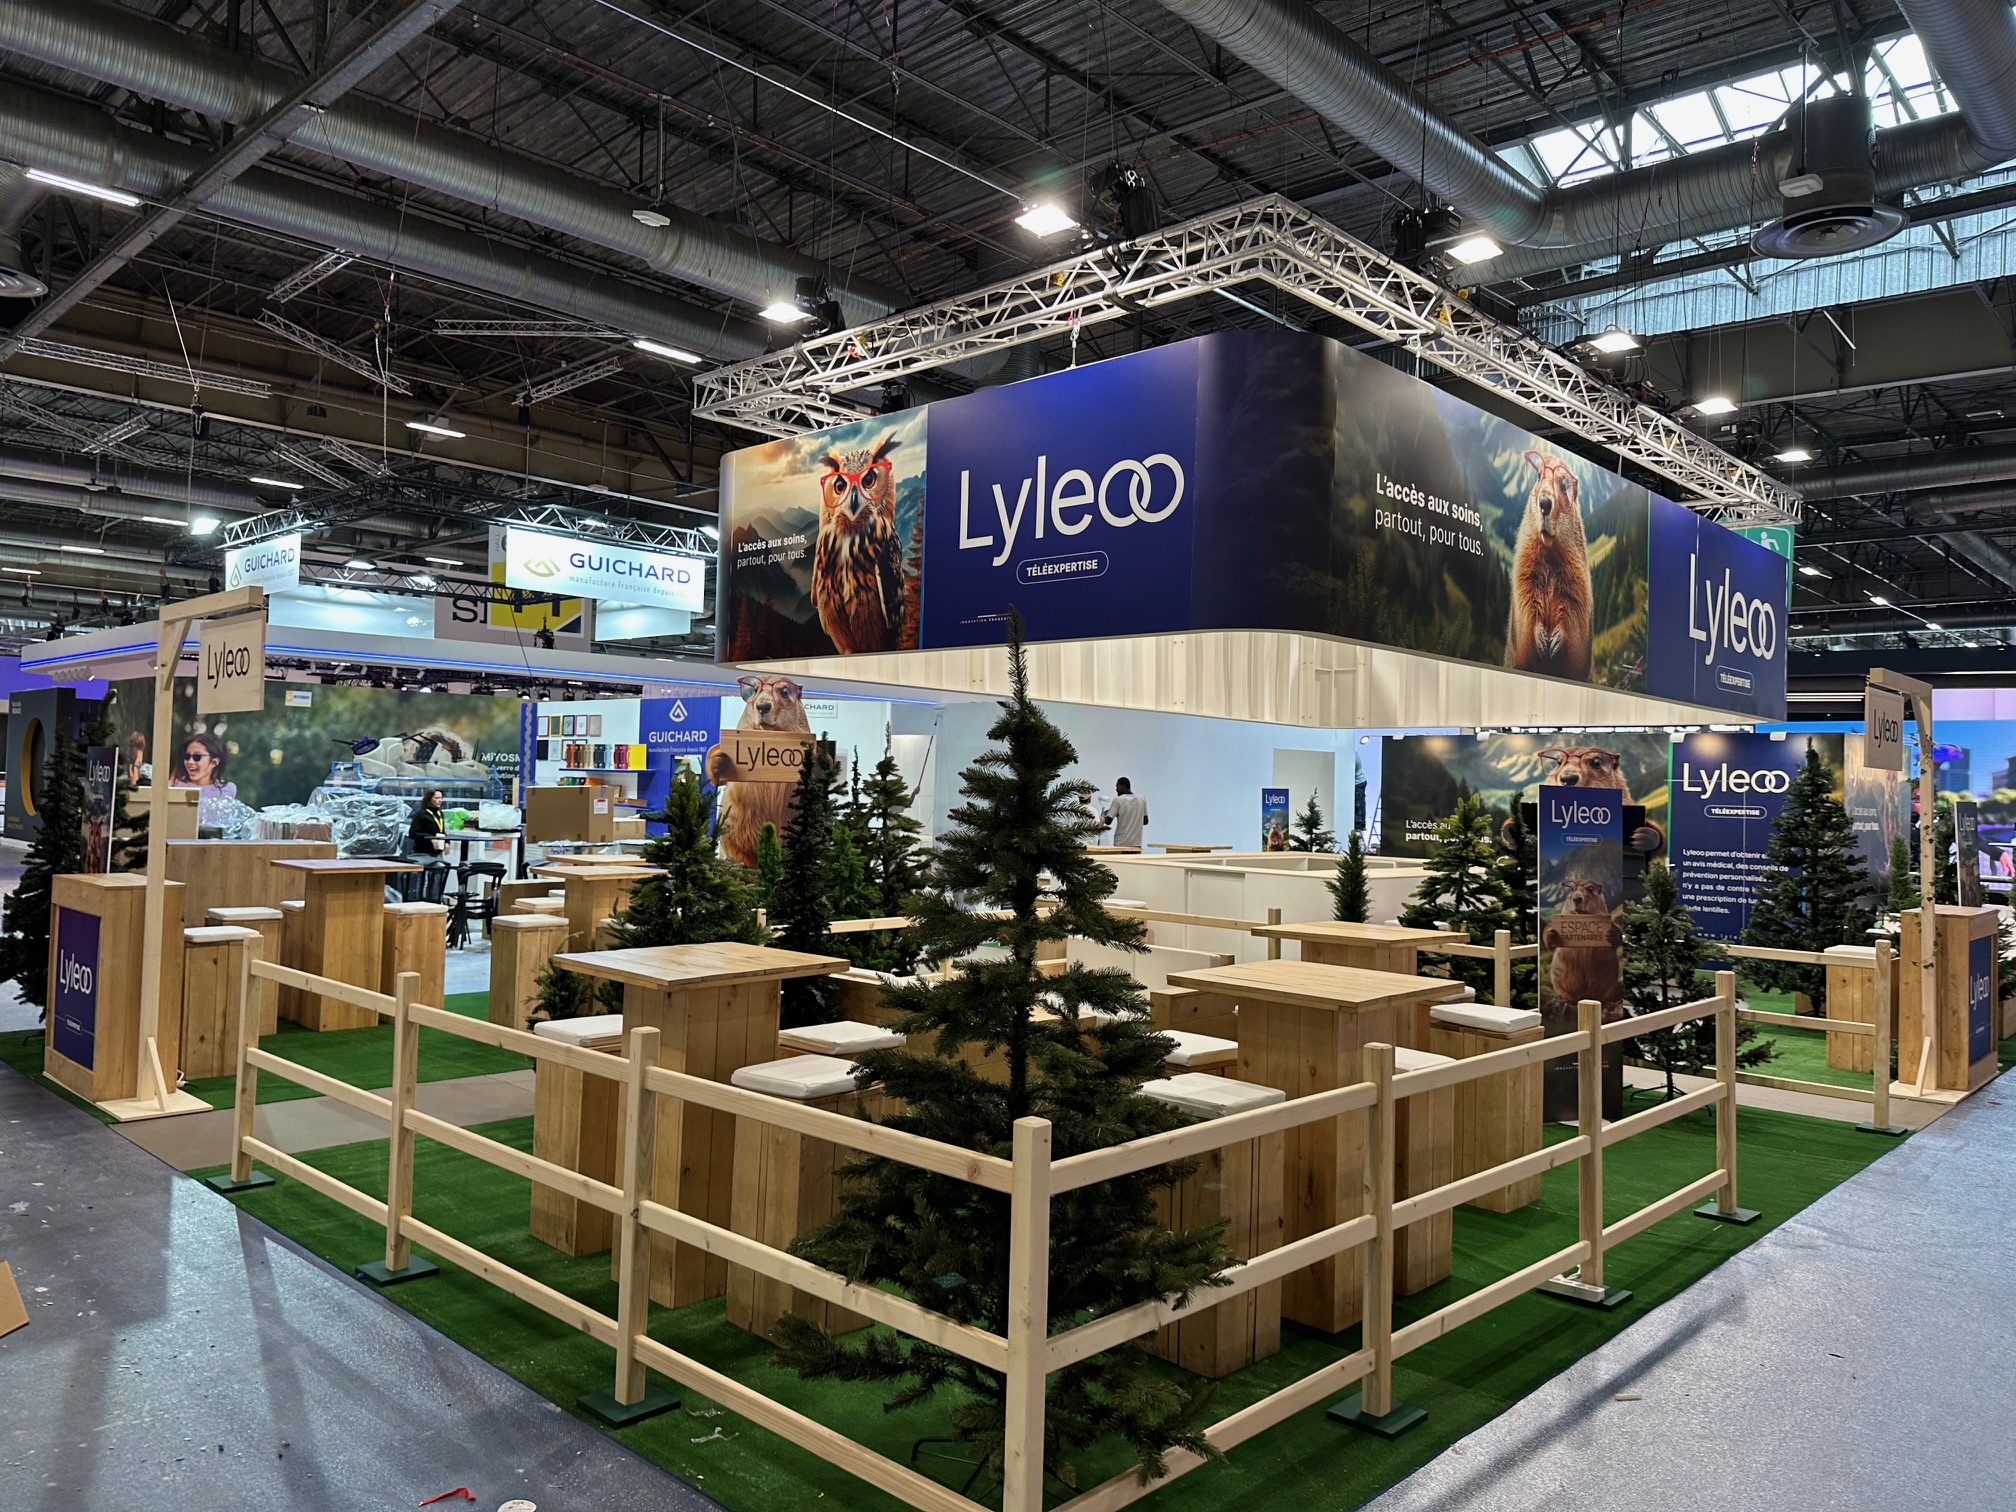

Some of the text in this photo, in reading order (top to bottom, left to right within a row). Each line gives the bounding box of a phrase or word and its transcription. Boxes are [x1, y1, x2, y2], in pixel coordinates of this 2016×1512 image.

[958, 453, 1185, 567] Lyleoo
[1376, 473, 1483, 532] L'accès aux soins,
[1375, 508, 1484, 556] partout, pour tous.
[738, 533, 807, 553] L'accès aux soins,
[244, 548, 295, 573] GUICHARD
[569, 553, 691, 584] GUICHARD
[737, 549, 807, 569] partout, pour tous.
[1026, 559, 1098, 577] TÉLÉEXPERTISE
[568, 576, 615, 588] manufacture
[618, 581, 650, 593] française
[1689, 553, 1776, 666] Lyleoo
[207, 642, 250, 689] Lyleoo
[804, 703, 844, 711] CHARD
[649, 731, 707, 743] GUICHARD
[1874, 709, 1898, 748] Lyleoo
[1683, 762, 1790, 799] Lyleoo
[1551, 800, 1611, 829] Lyleoo
[1711, 808, 1760, 816] TÉLÉEXPERTISE
[1406, 820, 1437, 829] L'accès
[1683, 871, 1718, 879] prévention
[1706, 861, 1735, 869] médical,
[1696, 894, 1737, 903] prescription
[1702, 906, 1731, 914] lentilles.
[1560, 921, 1603, 934] ESPACE
[1561, 933, 1603, 941] PARTENAIRES
[60, 949, 92, 994] Lyleoo
